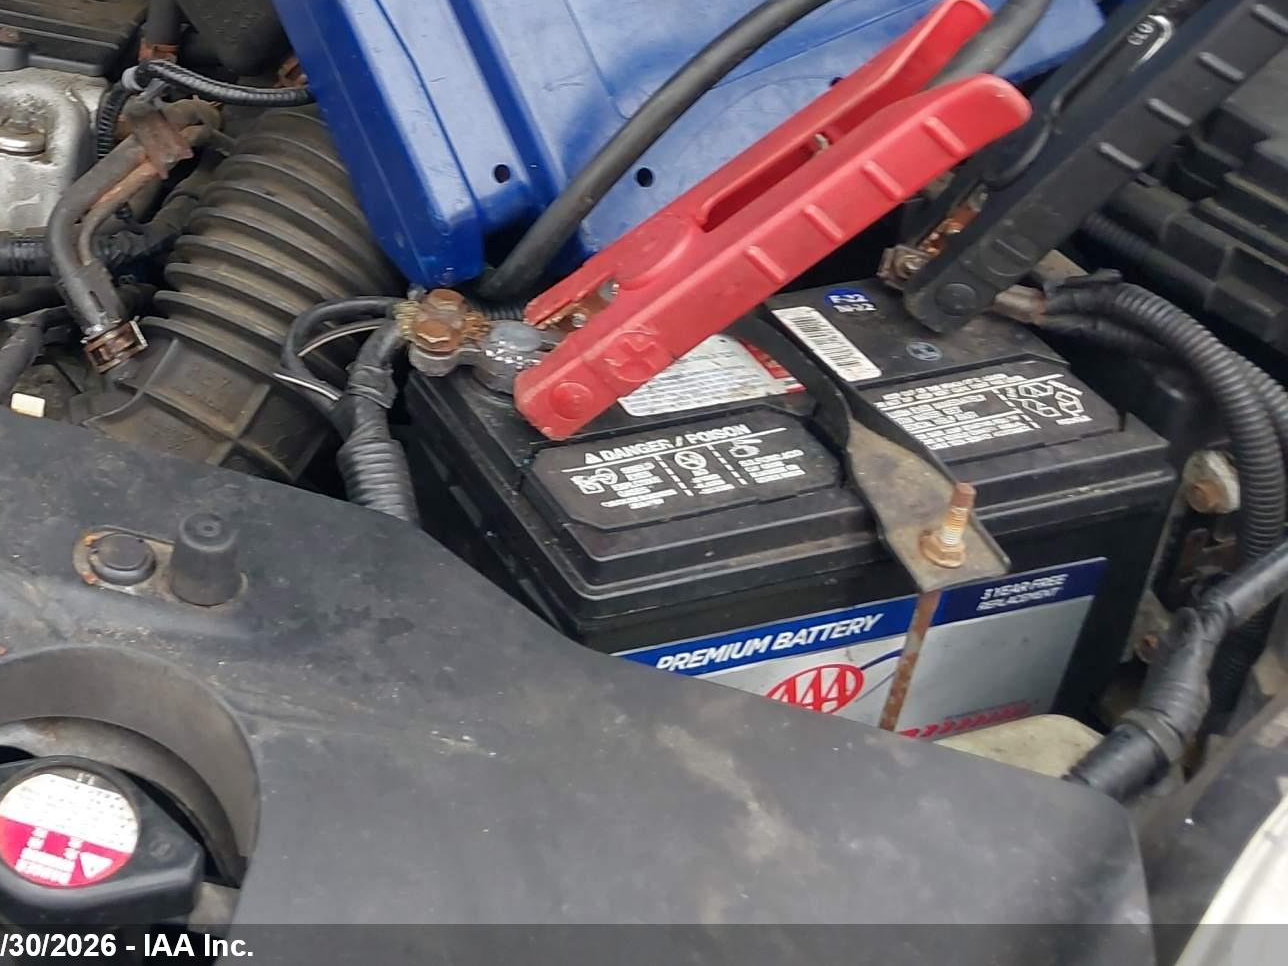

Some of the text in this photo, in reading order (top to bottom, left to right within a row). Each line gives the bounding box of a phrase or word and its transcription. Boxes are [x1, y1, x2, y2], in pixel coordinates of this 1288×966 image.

[599, 438, 675, 462] DANGER
[684, 423, 753, 446] POISON
[655, 613, 884, 672] PREMIUM BATTERY
